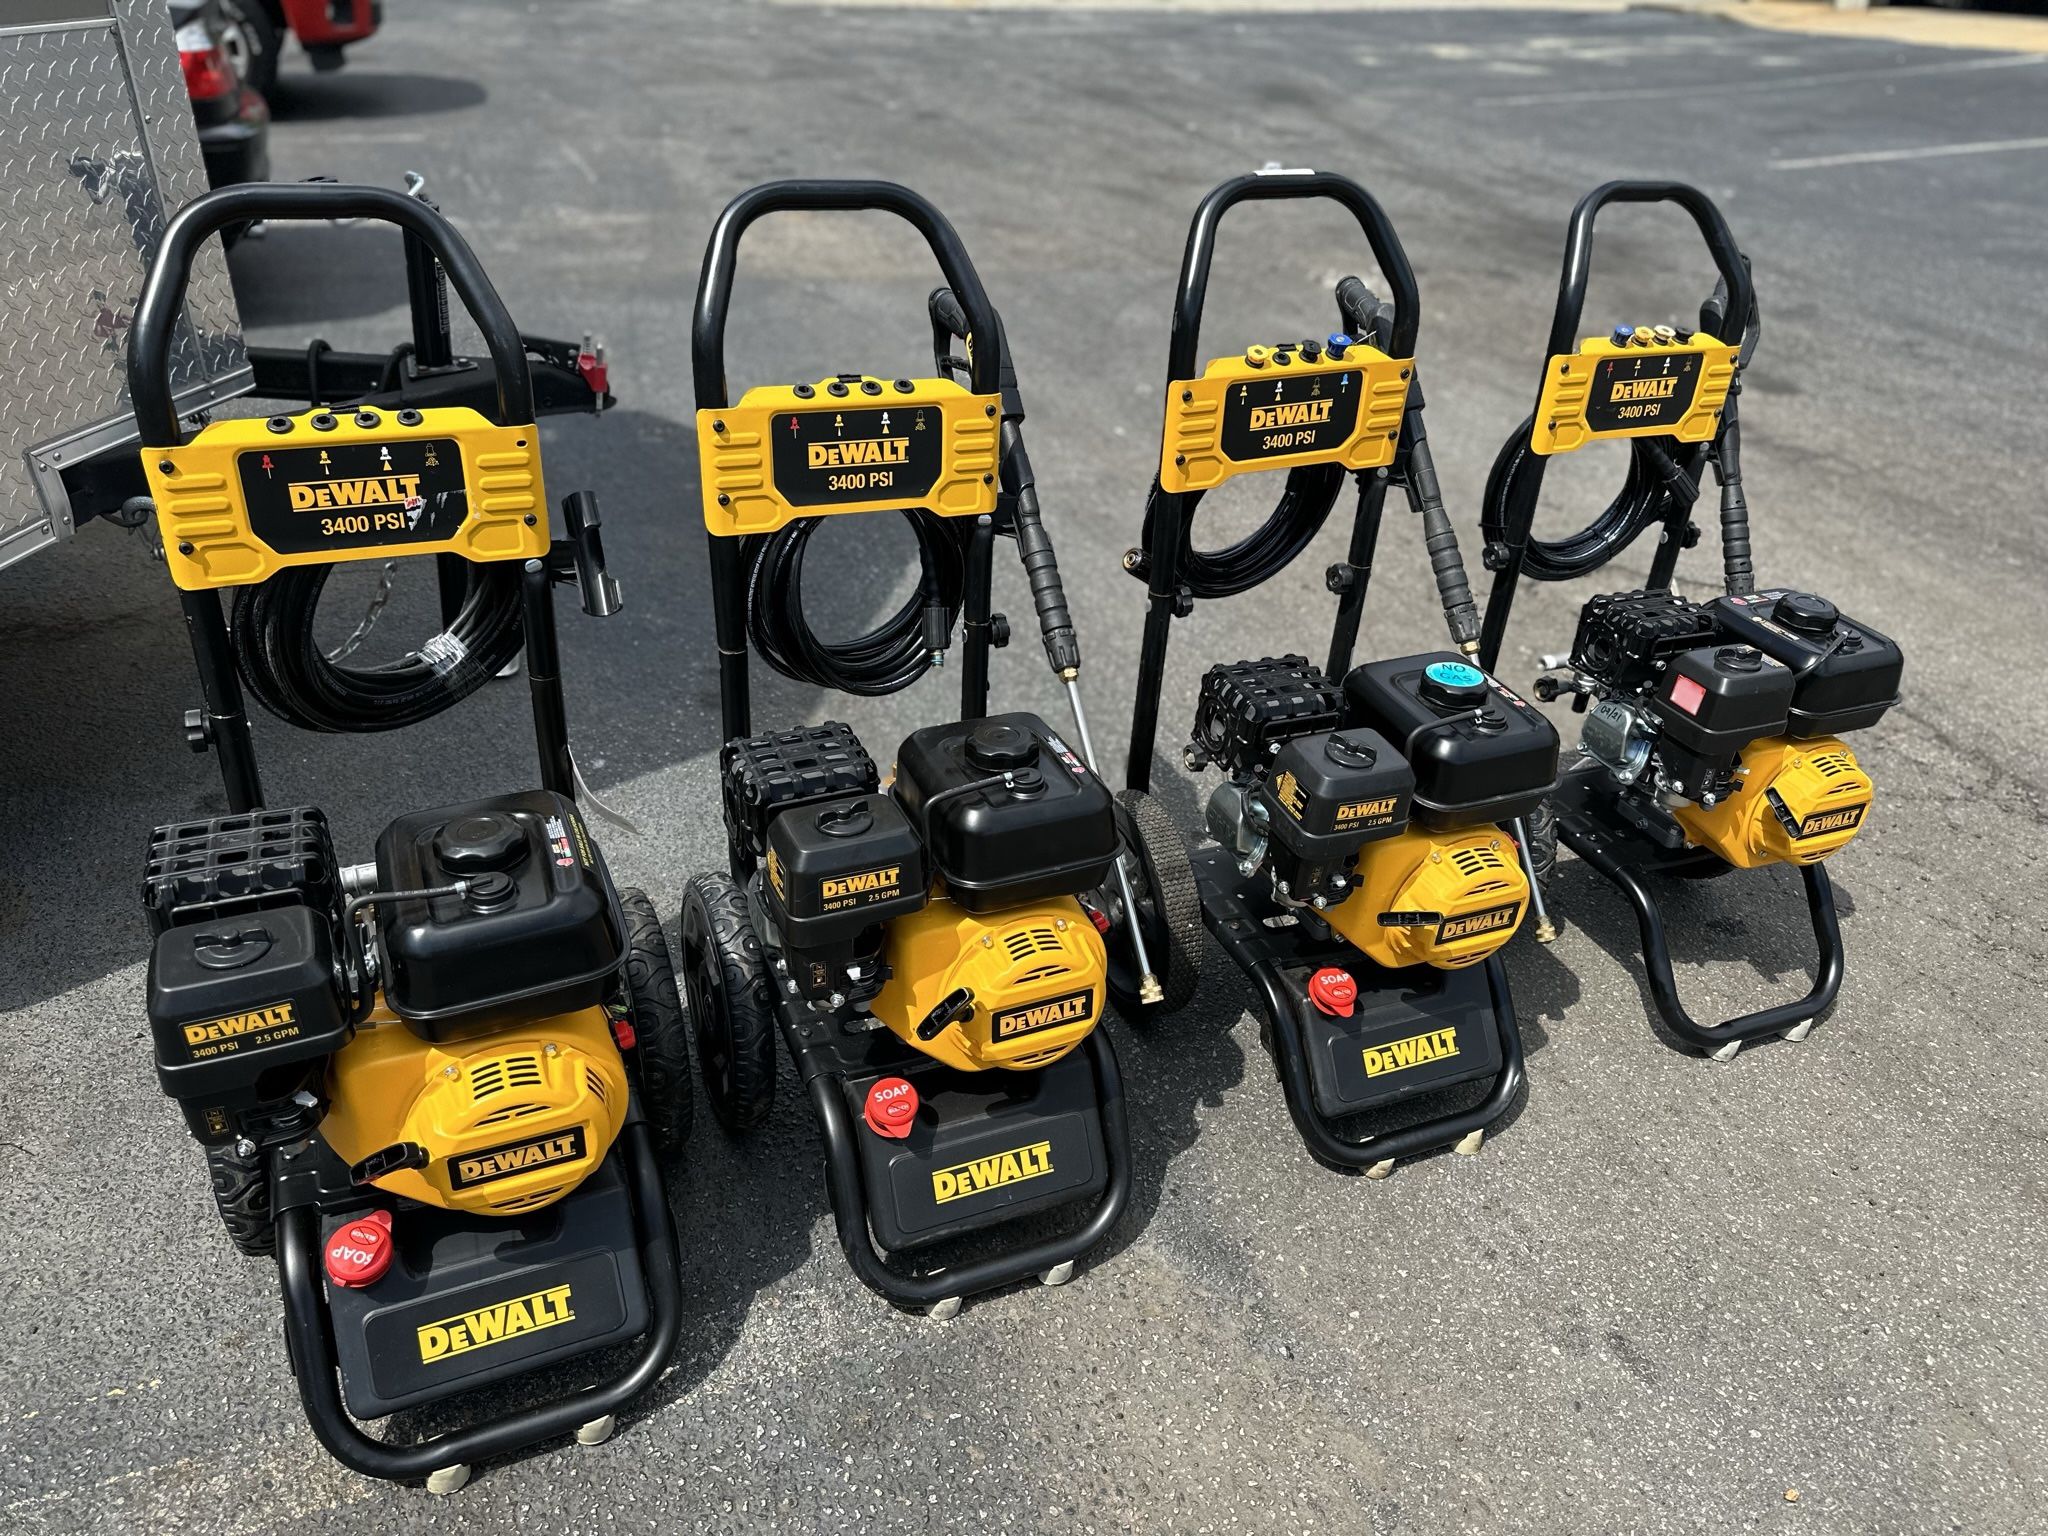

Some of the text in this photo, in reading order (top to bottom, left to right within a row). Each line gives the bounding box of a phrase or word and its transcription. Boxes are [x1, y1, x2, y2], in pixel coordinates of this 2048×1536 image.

[1617, 403, 1661, 419] 3400 PSI
[1262, 429, 1316, 450] 3400 PSI
[828, 471, 894, 491] 3400 PSI
[320, 512, 406, 536] 3400 PSI
[1439, 672, 1473, 682] GAS
[1441, 663, 1466, 673] NO
[1333, 823, 1348, 831] 3400
[1348, 821, 1360, 829] PSI
[1377, 816, 1393, 825] GPM
[823, 889, 900, 911] 3400 PSI 2.5 GPM
[1320, 972, 1350, 985] SOAP
[192, 1026, 300, 1059] 3400 PSI 2.5 GPM
[874, 1084, 909, 1103] SOAP
[331, 1245, 374, 1265] SOAP
